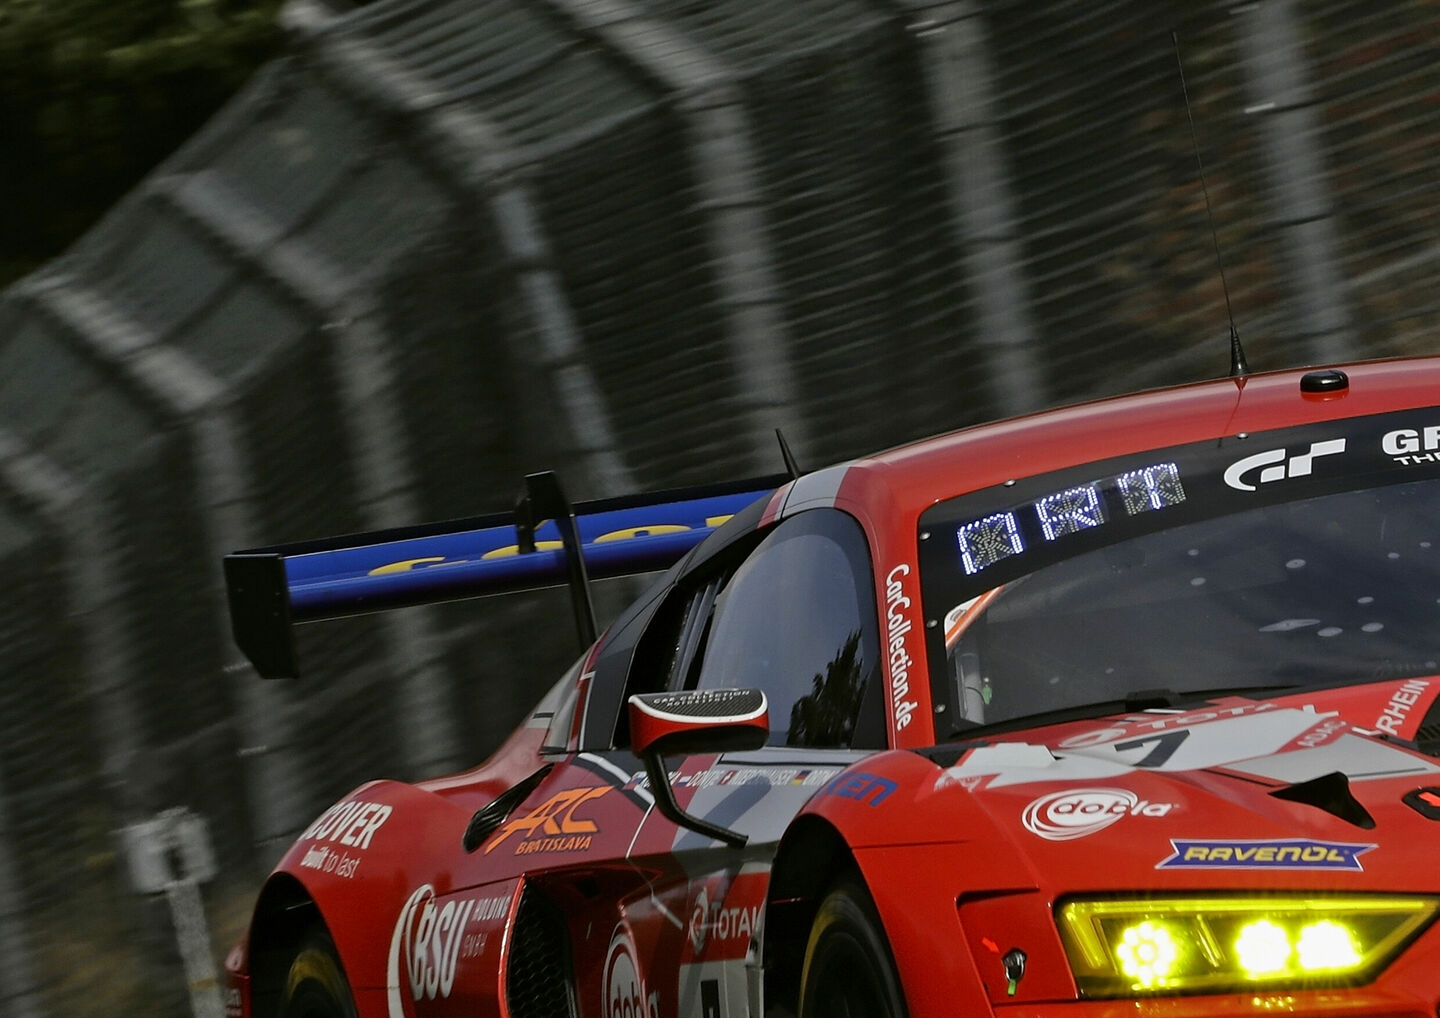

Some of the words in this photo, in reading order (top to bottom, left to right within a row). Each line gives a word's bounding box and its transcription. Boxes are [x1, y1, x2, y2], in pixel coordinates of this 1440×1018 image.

[886, 563, 919, 732] CarCollection.de
[1375, 678, 1431, 737] RHEIN
[1113, 729, 1192, 768] 7
[334, 851, 361, 879] last
[514, 836, 593, 856] BRATISLAVA
[1184, 847, 1346, 862] RAVENOL
[413, 899, 475, 1001] BSU
